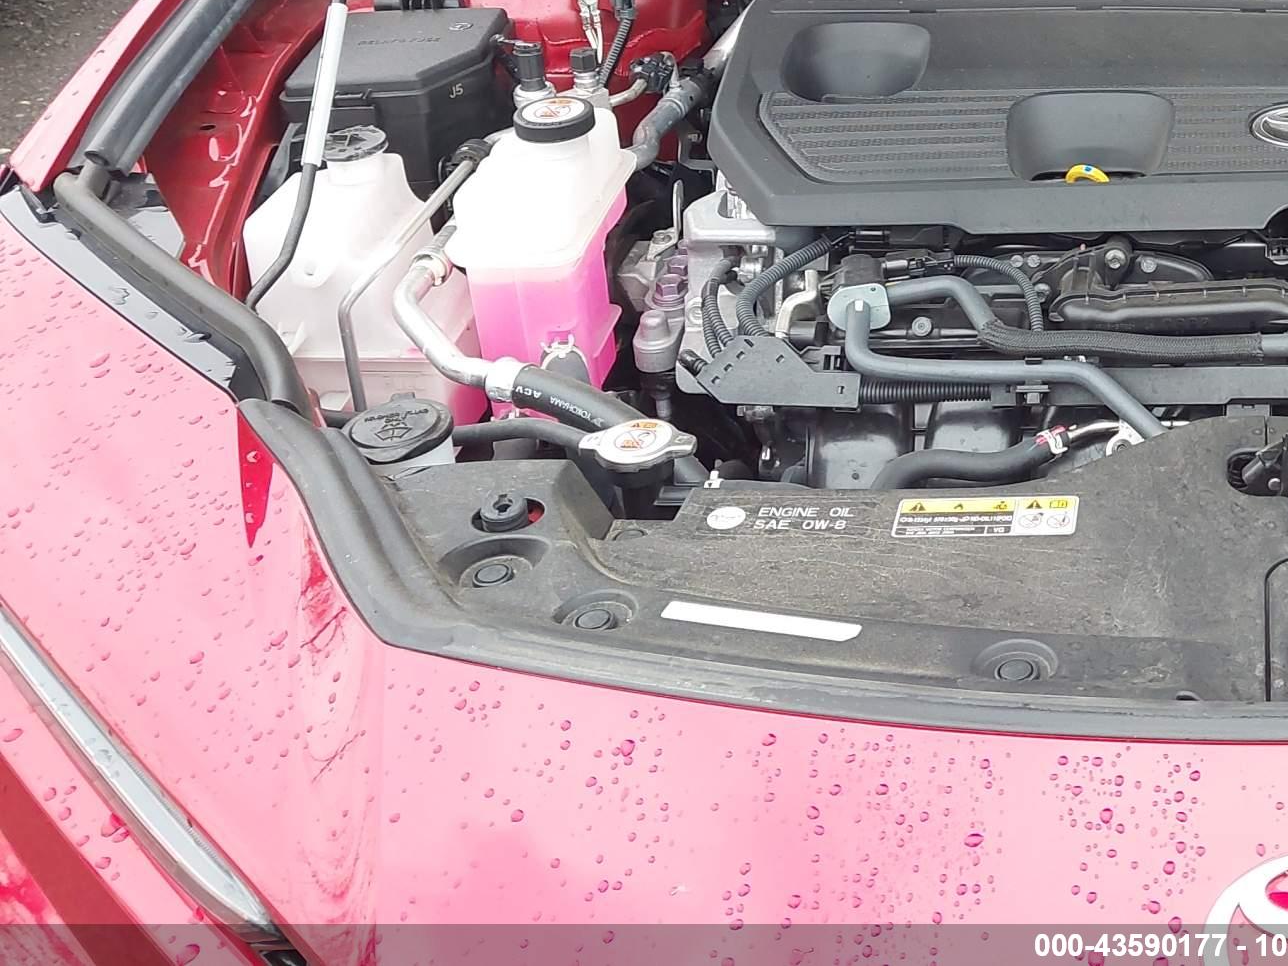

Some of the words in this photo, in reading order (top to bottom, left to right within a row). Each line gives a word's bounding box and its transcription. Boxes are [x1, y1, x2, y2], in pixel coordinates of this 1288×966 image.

[449, 83, 464, 99] J5
[515, 385, 542, 399] ACV
[550, 395, 592, 420] YOKOHAMA
[758, 507, 820, 517] ENGINE
[829, 507, 854, 517] OIL
[753, 520, 791, 530] SAE
